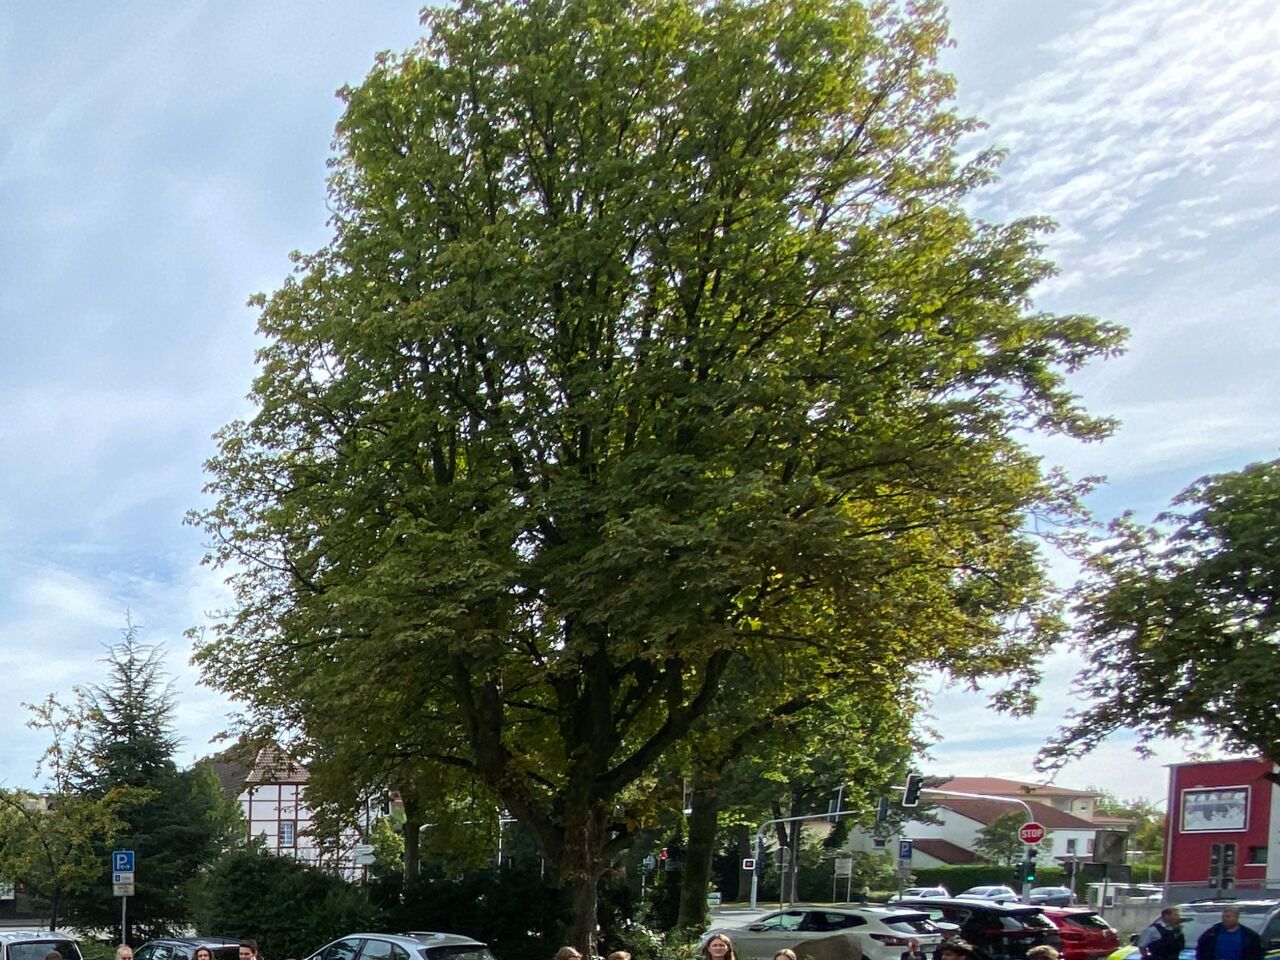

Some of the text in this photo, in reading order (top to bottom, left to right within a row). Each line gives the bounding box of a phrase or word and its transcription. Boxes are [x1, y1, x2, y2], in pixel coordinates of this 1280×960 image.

[1021, 829, 1043, 838] STOP
[901, 842, 909, 856] P
[116, 854, 128, 870] P
